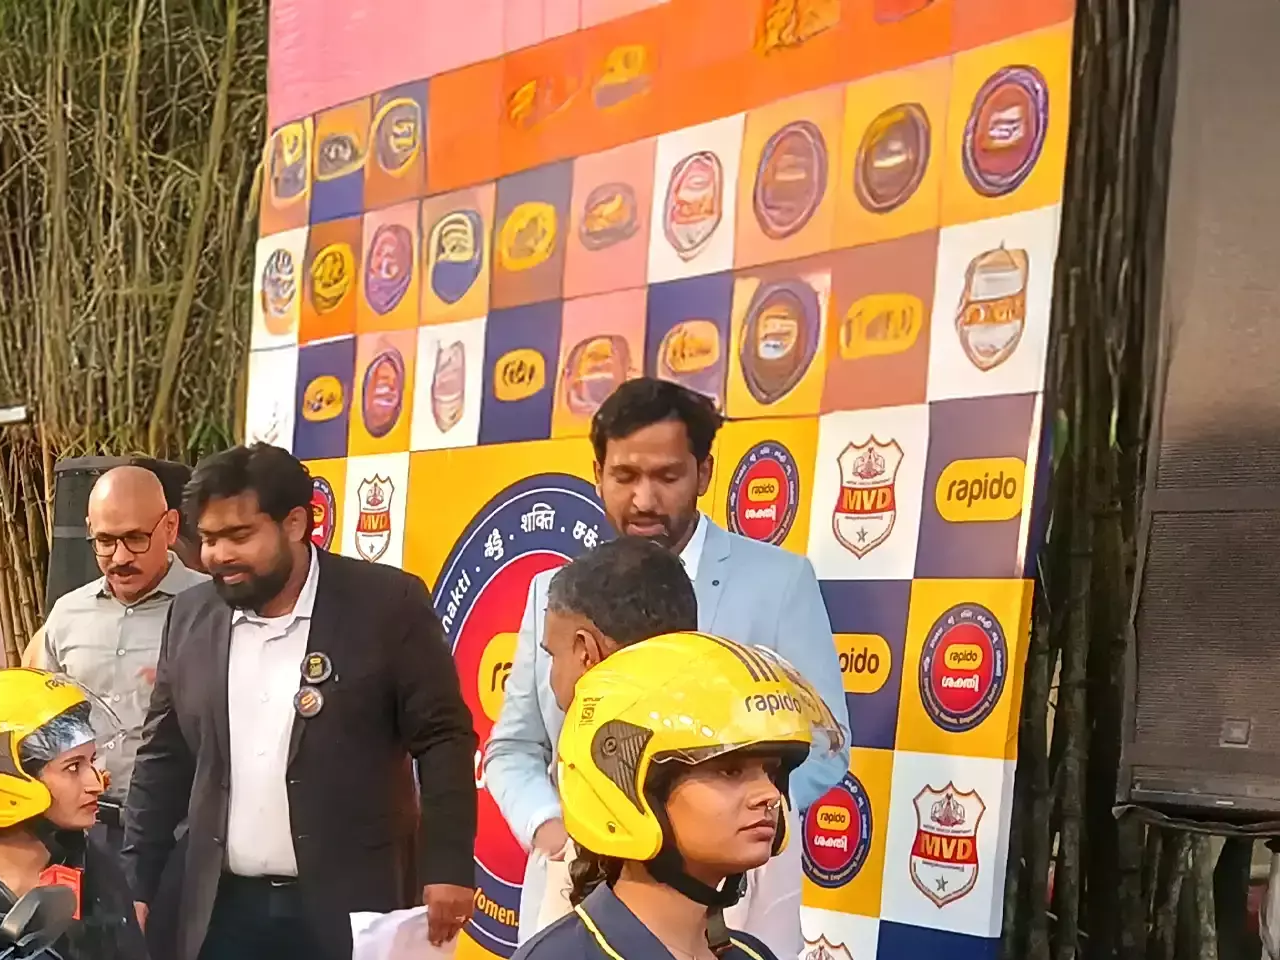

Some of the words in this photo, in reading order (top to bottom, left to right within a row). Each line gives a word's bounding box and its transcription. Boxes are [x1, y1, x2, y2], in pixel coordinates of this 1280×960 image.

[752, 483, 775, 496] rapido
[842, 487, 892, 511] MVD
[947, 471, 1017, 508] rapido
[361, 513, 389, 531] MVD
[520, 502, 556, 533] शक्ति
[838, 647, 880, 674] pido
[950, 650, 978, 664] rapido
[745, 689, 802, 716] rapido
[820, 812, 846, 825] rapido
[920, 832, 973, 861] MVD
